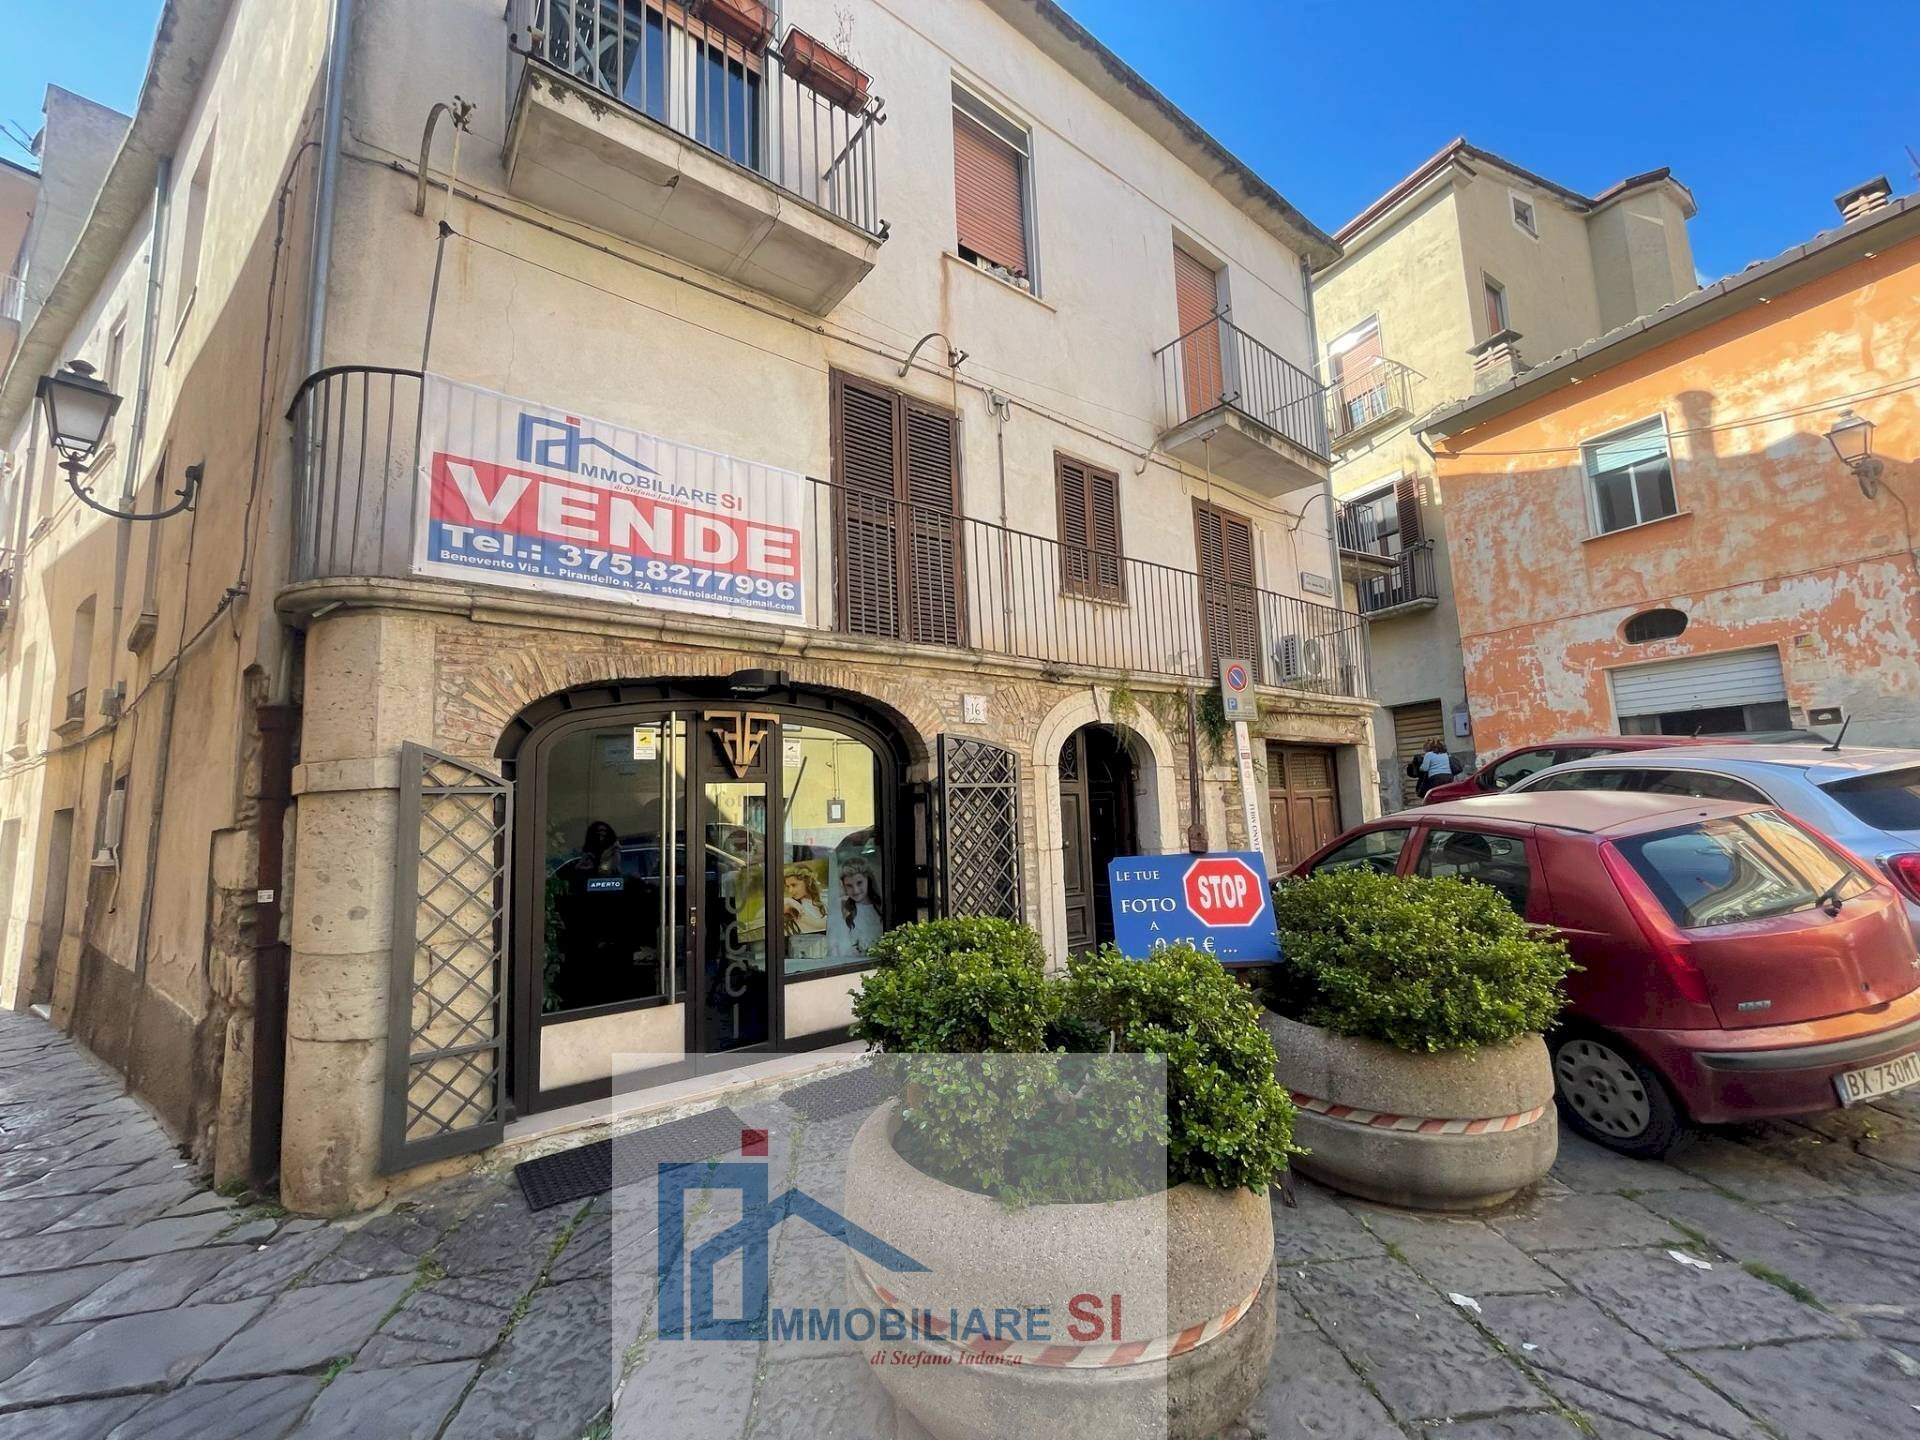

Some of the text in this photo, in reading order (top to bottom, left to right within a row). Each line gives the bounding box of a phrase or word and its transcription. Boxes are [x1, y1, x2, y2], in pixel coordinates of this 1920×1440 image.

[720, 492, 743, 512] SI
[446, 460, 796, 577] VENDE
[440, 549, 514, 570] Benevento
[518, 562, 539, 574] Via
[543, 566, 555, 576] L.
[559, 568, 620, 587] Pirandello
[623, 579, 633, 588] n.
[636, 581, 652, 592] 2A
[441, 523, 796, 601] Tel.: 375.8277996
[971, 702, 981, 716] 16
[1115, 870, 1160, 882] LE TUE
[1197, 873, 1247, 910] STOP
[1121, 897, 1176, 913] FOTO
[1150, 921, 1160, 931] A
[1202, 936, 1216, 953] €
[1847, 1070, 1873, 1097] BX
